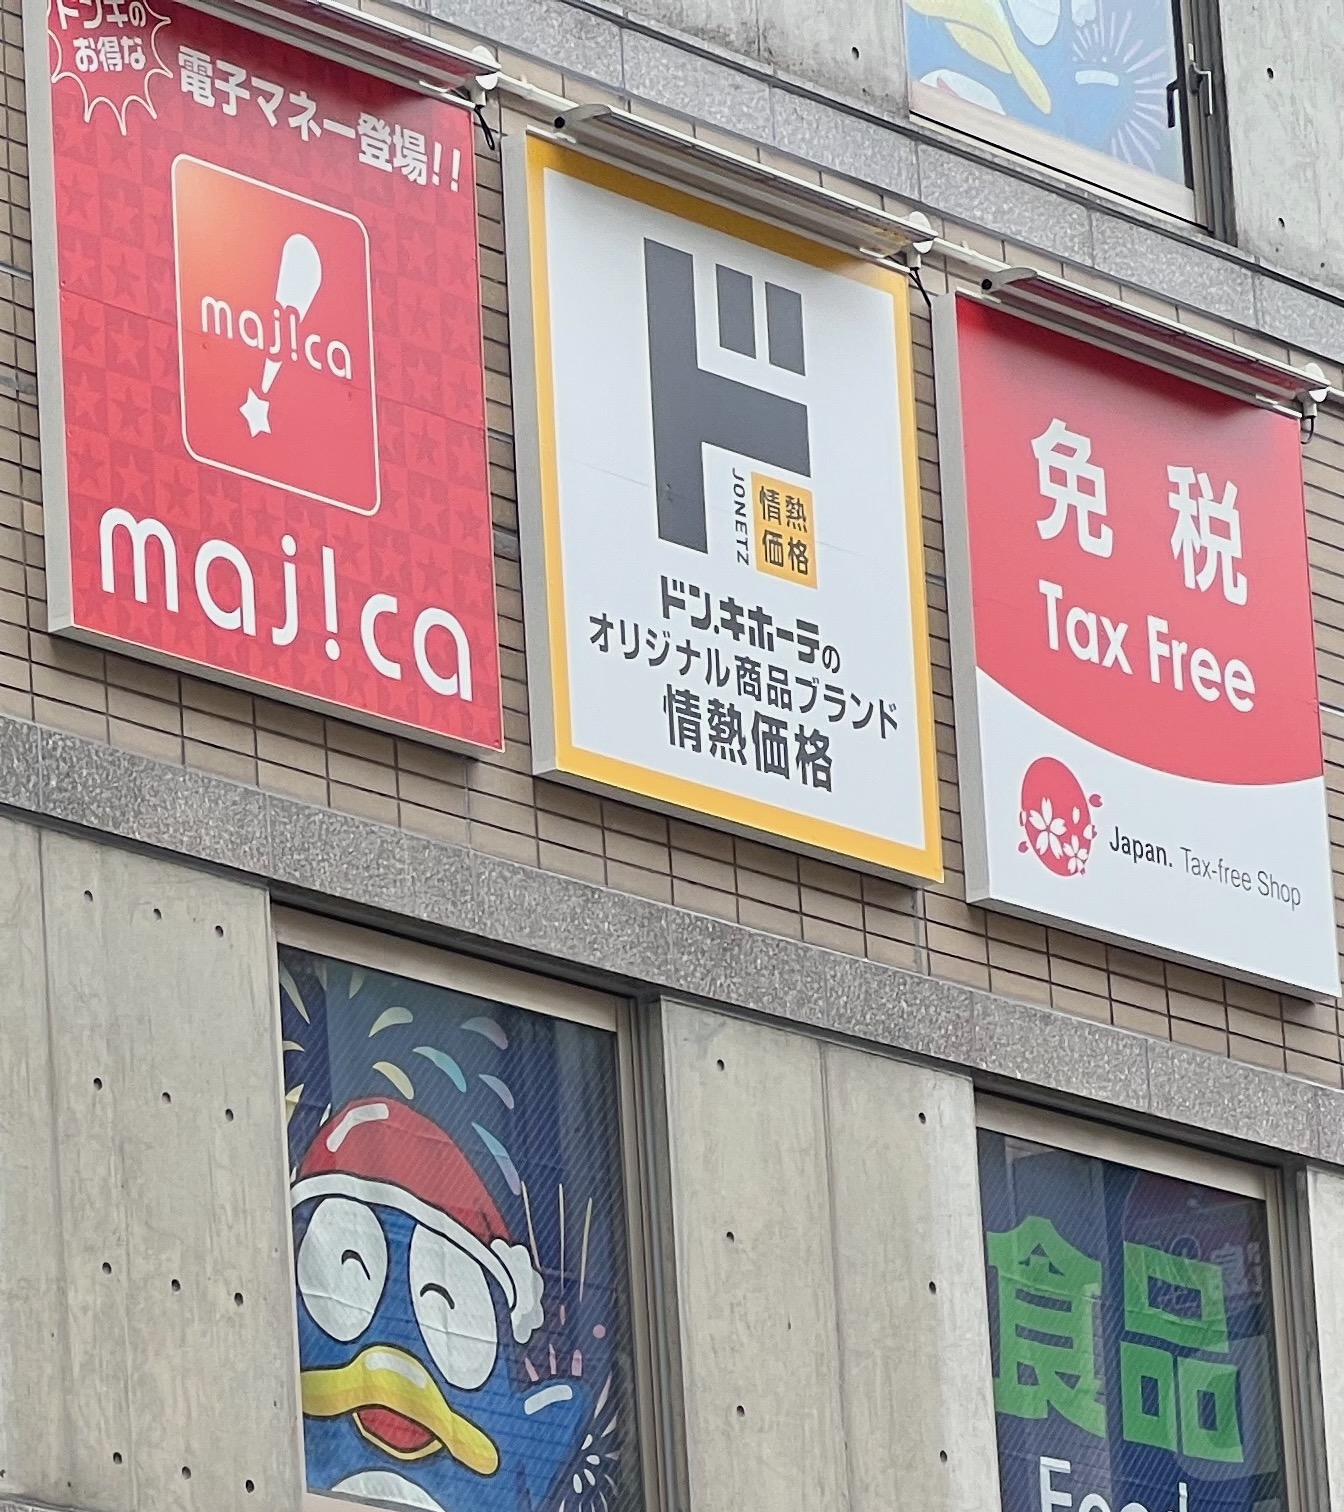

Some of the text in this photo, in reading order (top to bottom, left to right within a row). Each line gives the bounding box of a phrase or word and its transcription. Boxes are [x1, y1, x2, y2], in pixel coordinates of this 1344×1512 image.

[73, 36, 146, 72] お得な
[732, 467, 750, 566] JONETZ
[589, 612, 898, 739] オリジナル商品ブランド
[1039, 580, 1256, 714] Tax Free
[663, 683, 833, 793] 情熱価格
[1109, 825, 1302, 910] Japan. Tax-free Shop
[986, 1215, 1245, 1464] 食品
